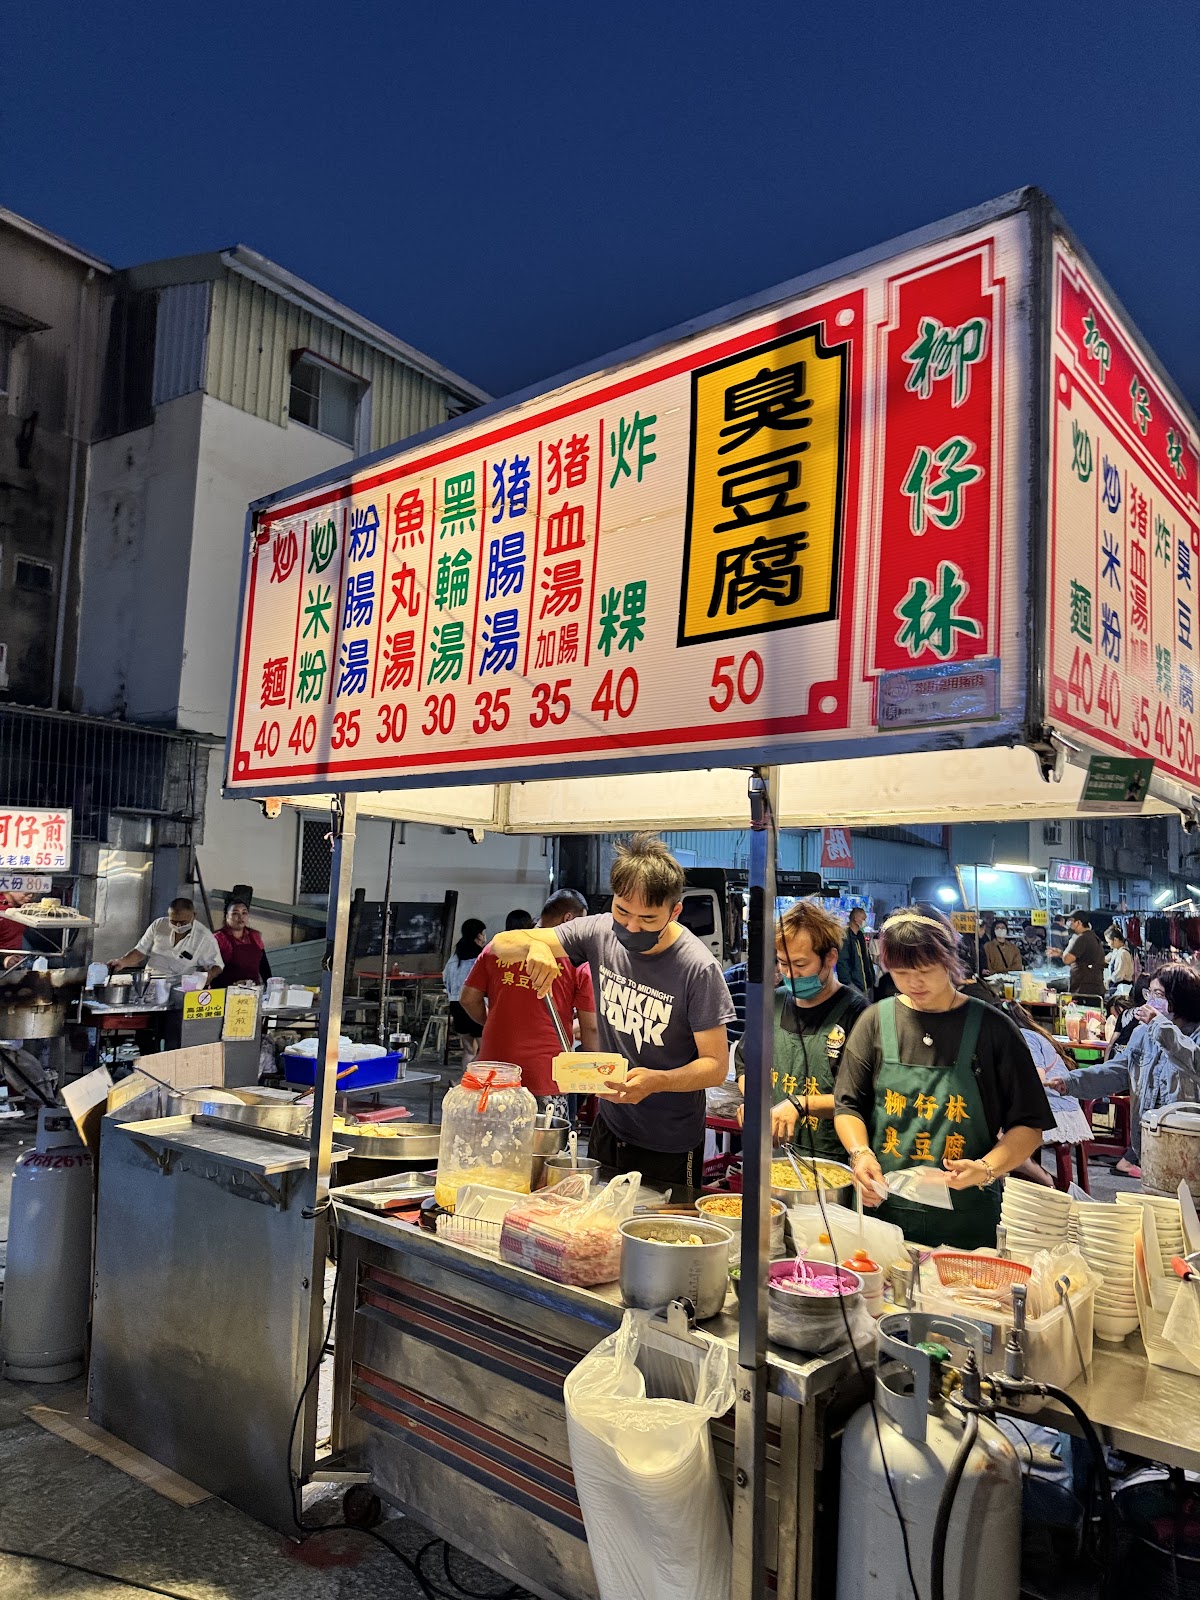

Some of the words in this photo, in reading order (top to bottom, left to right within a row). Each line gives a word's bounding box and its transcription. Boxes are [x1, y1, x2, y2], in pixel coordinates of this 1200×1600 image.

[706, 362, 814, 619] 臭豆腐
[896, 315, 991, 659] 柳仔林
[597, 410, 658, 658] 炸粿
[1070, 418, 1093, 644] 炒麵
[1102, 453, 1122, 663] 炒米粉
[336, 504, 380, 698] 粉腸湯
[380, 488, 425, 692] 魚丸湯
[426, 470, 476, 685] 黑輪湯
[260, 531, 298, 710] 炒麵
[296, 518, 337, 704] 炒米粉
[530, 679, 572, 729] 35
[591, 667, 639, 721] 40
[709, 650, 763, 713] 50
[1068, 646, 1093, 715] 40
[1098, 663, 1121, 729] 40
[288, 715, 317, 756] 40
[331, 709, 361, 750] 35
[376, 703, 407, 744] 30
[421, 693, 455, 735] 30
[472, 688, 511, 735] 35
[1132, 693, 1150, 748] 35
[1155, 701, 1173, 758] 40
[254, 721, 280, 759] 40
[1178, 717, 1194, 772] 50
[501, 971, 537, 990] 臭豆
[627, 978, 637, 988] TO
[637, 983, 675, 1003] MIDNIGHT
[884, 1088, 970, 1123] 柳仔林
[882, 1126, 966, 1161] 臭豆腐
